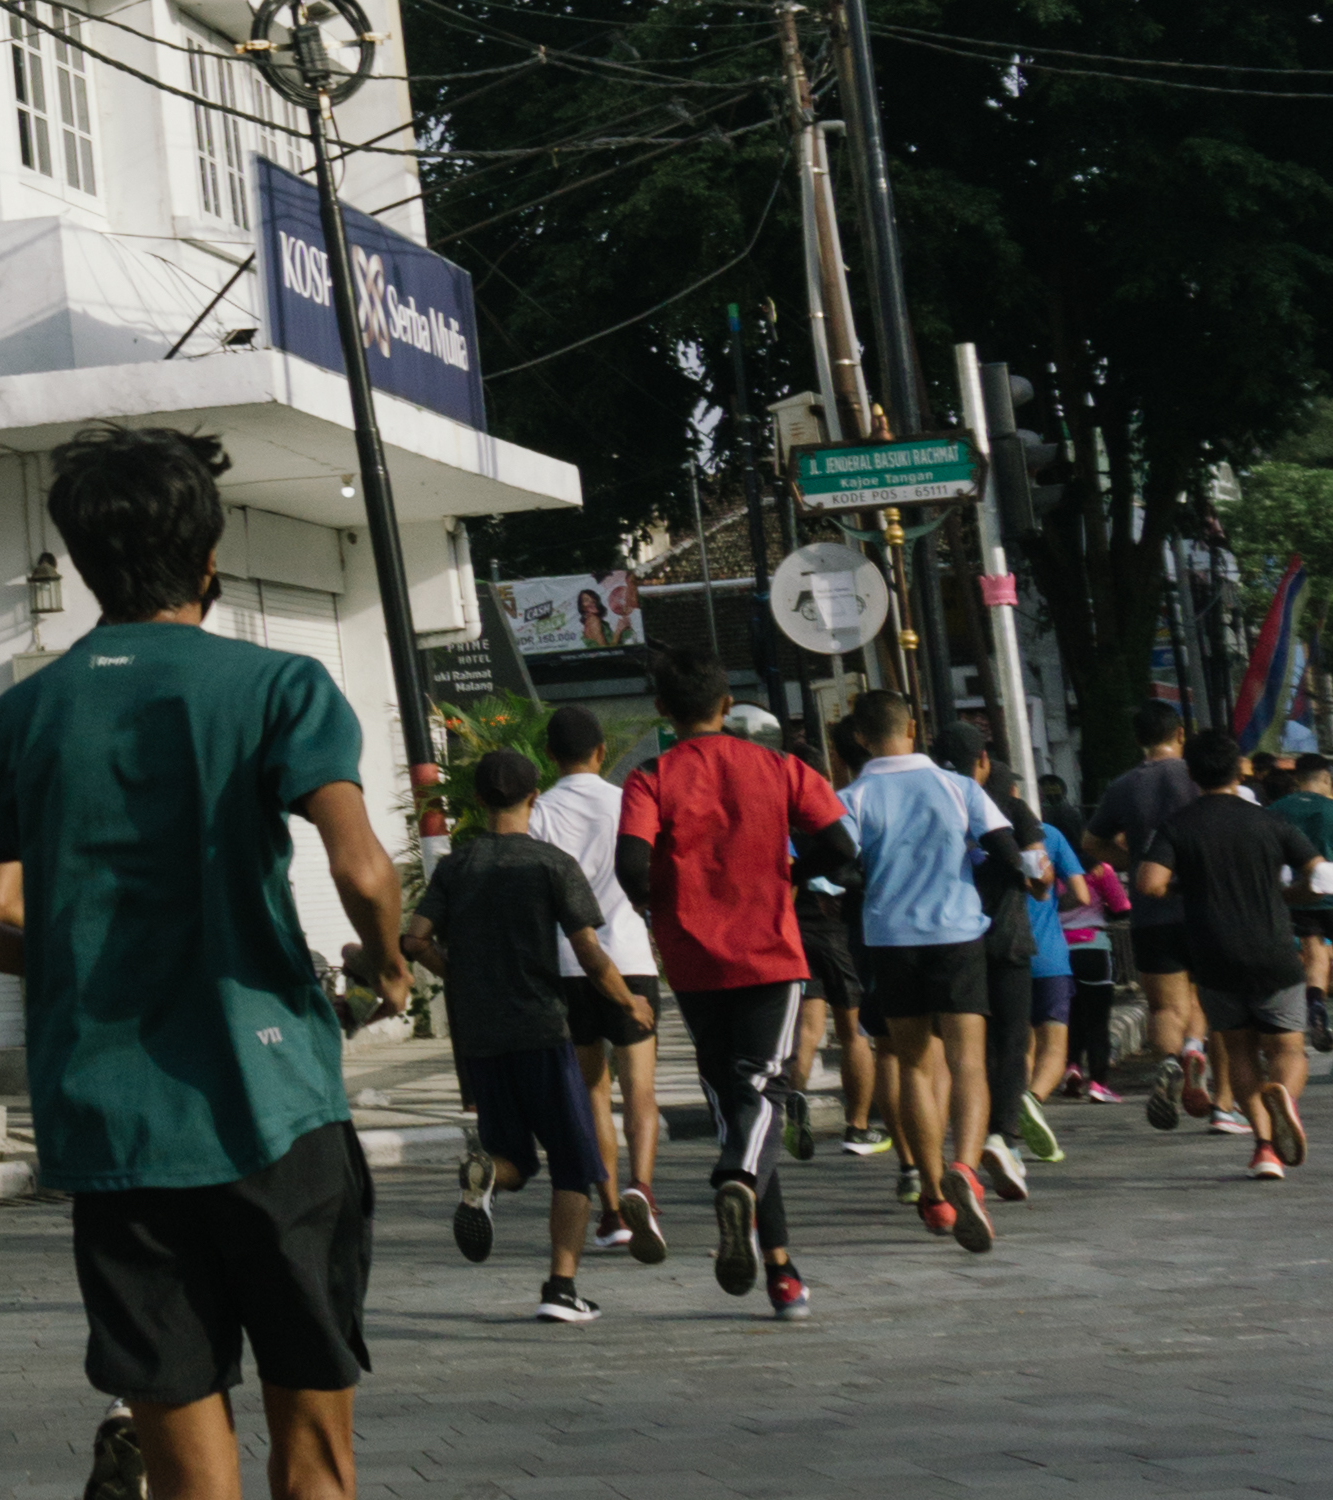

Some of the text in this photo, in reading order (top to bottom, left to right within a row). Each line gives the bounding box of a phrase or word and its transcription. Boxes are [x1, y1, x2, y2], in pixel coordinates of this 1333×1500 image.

[386, 284, 432, 354] Serba
[428, 306, 469, 372] Mulia
[825, 453, 873, 474] JENDERAL
[874, 449, 912, 470] BASUKI
[912, 445, 960, 466] RACHMAT
[840, 471, 934, 490] Kajoe Tangan
[833, 490, 867, 505] KODE
[872, 488, 898, 501] POS
[915, 484, 948, 498] 65111
[525, 602, 552, 621] CASH
[447, 639, 490, 653] PRIME
[458, 654, 492, 665] HOTEL
[452, 669, 492, 681] Rahmat
[455, 682, 493, 693] Malang
[255, 1026, 283, 1046] VII
